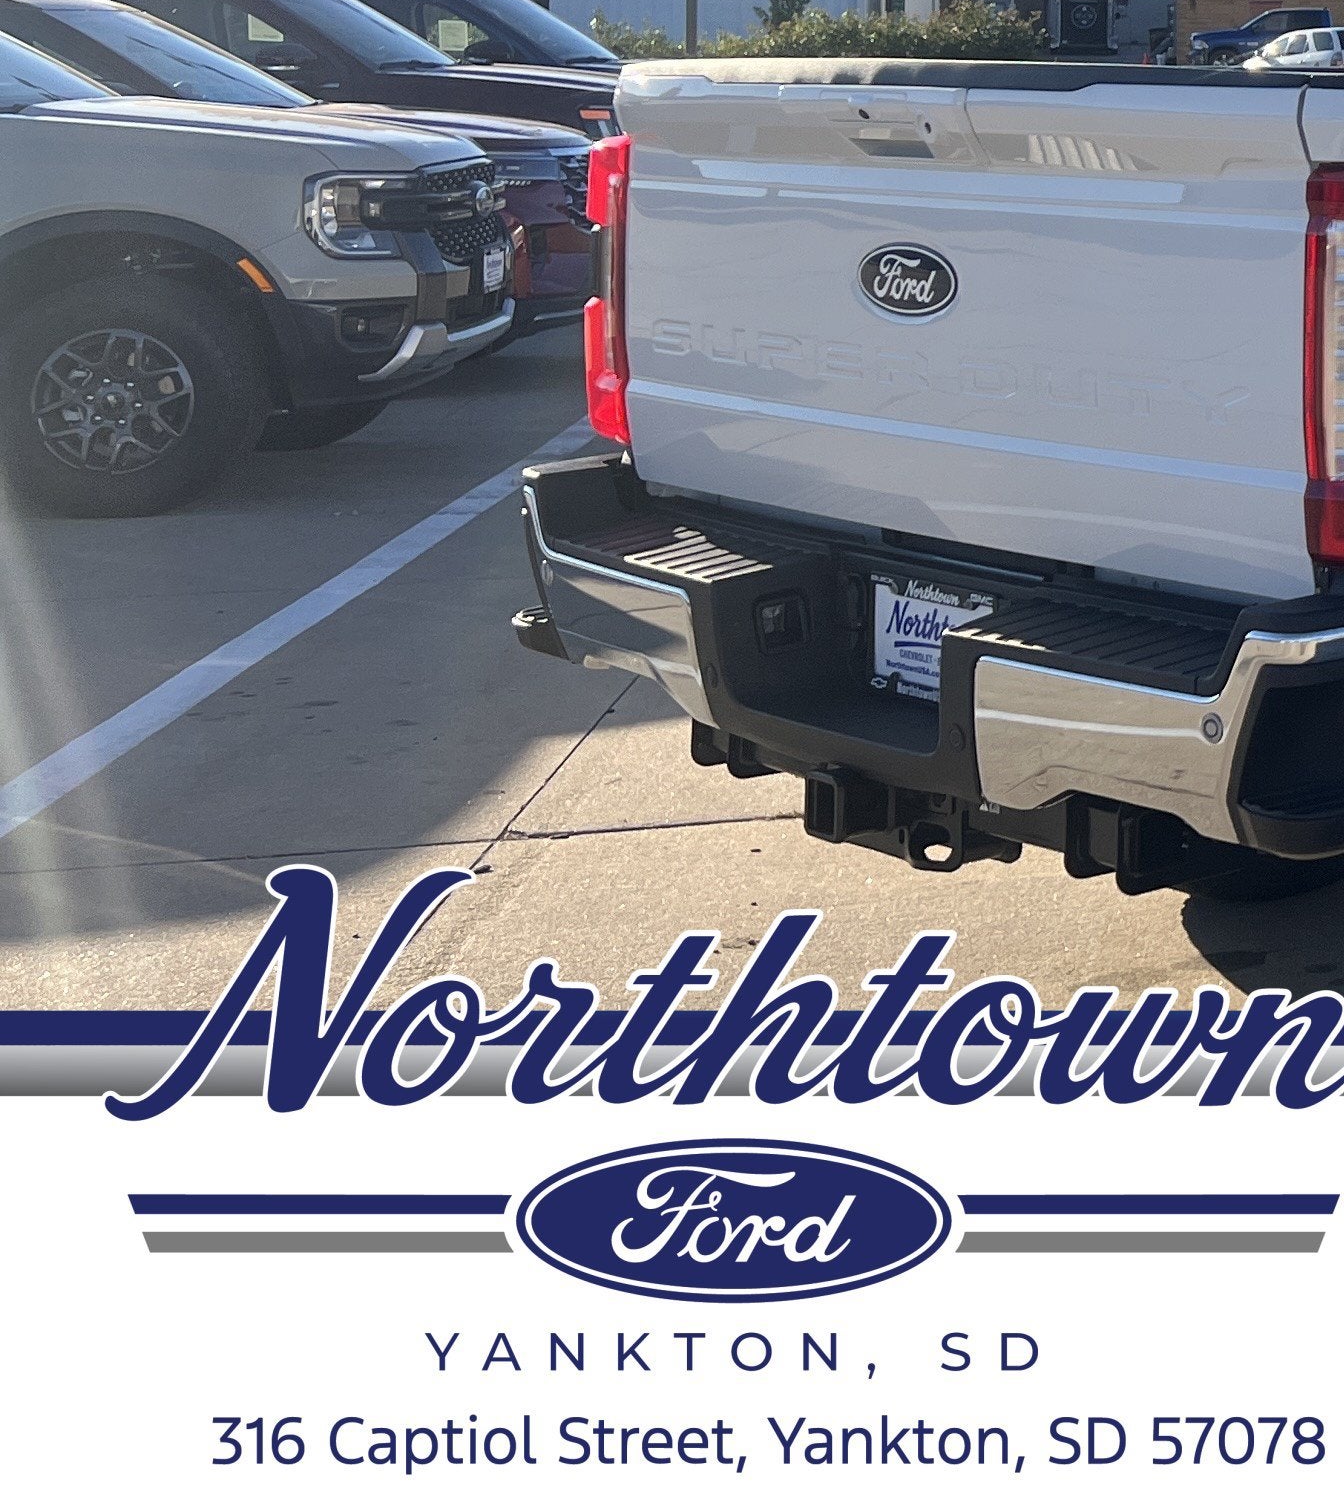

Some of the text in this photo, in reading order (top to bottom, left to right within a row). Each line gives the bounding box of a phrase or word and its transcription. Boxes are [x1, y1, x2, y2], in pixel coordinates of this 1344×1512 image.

[873, 253, 937, 303] Ford
[652, 317, 1252, 423] SUPER DUTY
[904, 579, 961, 607] Northtown
